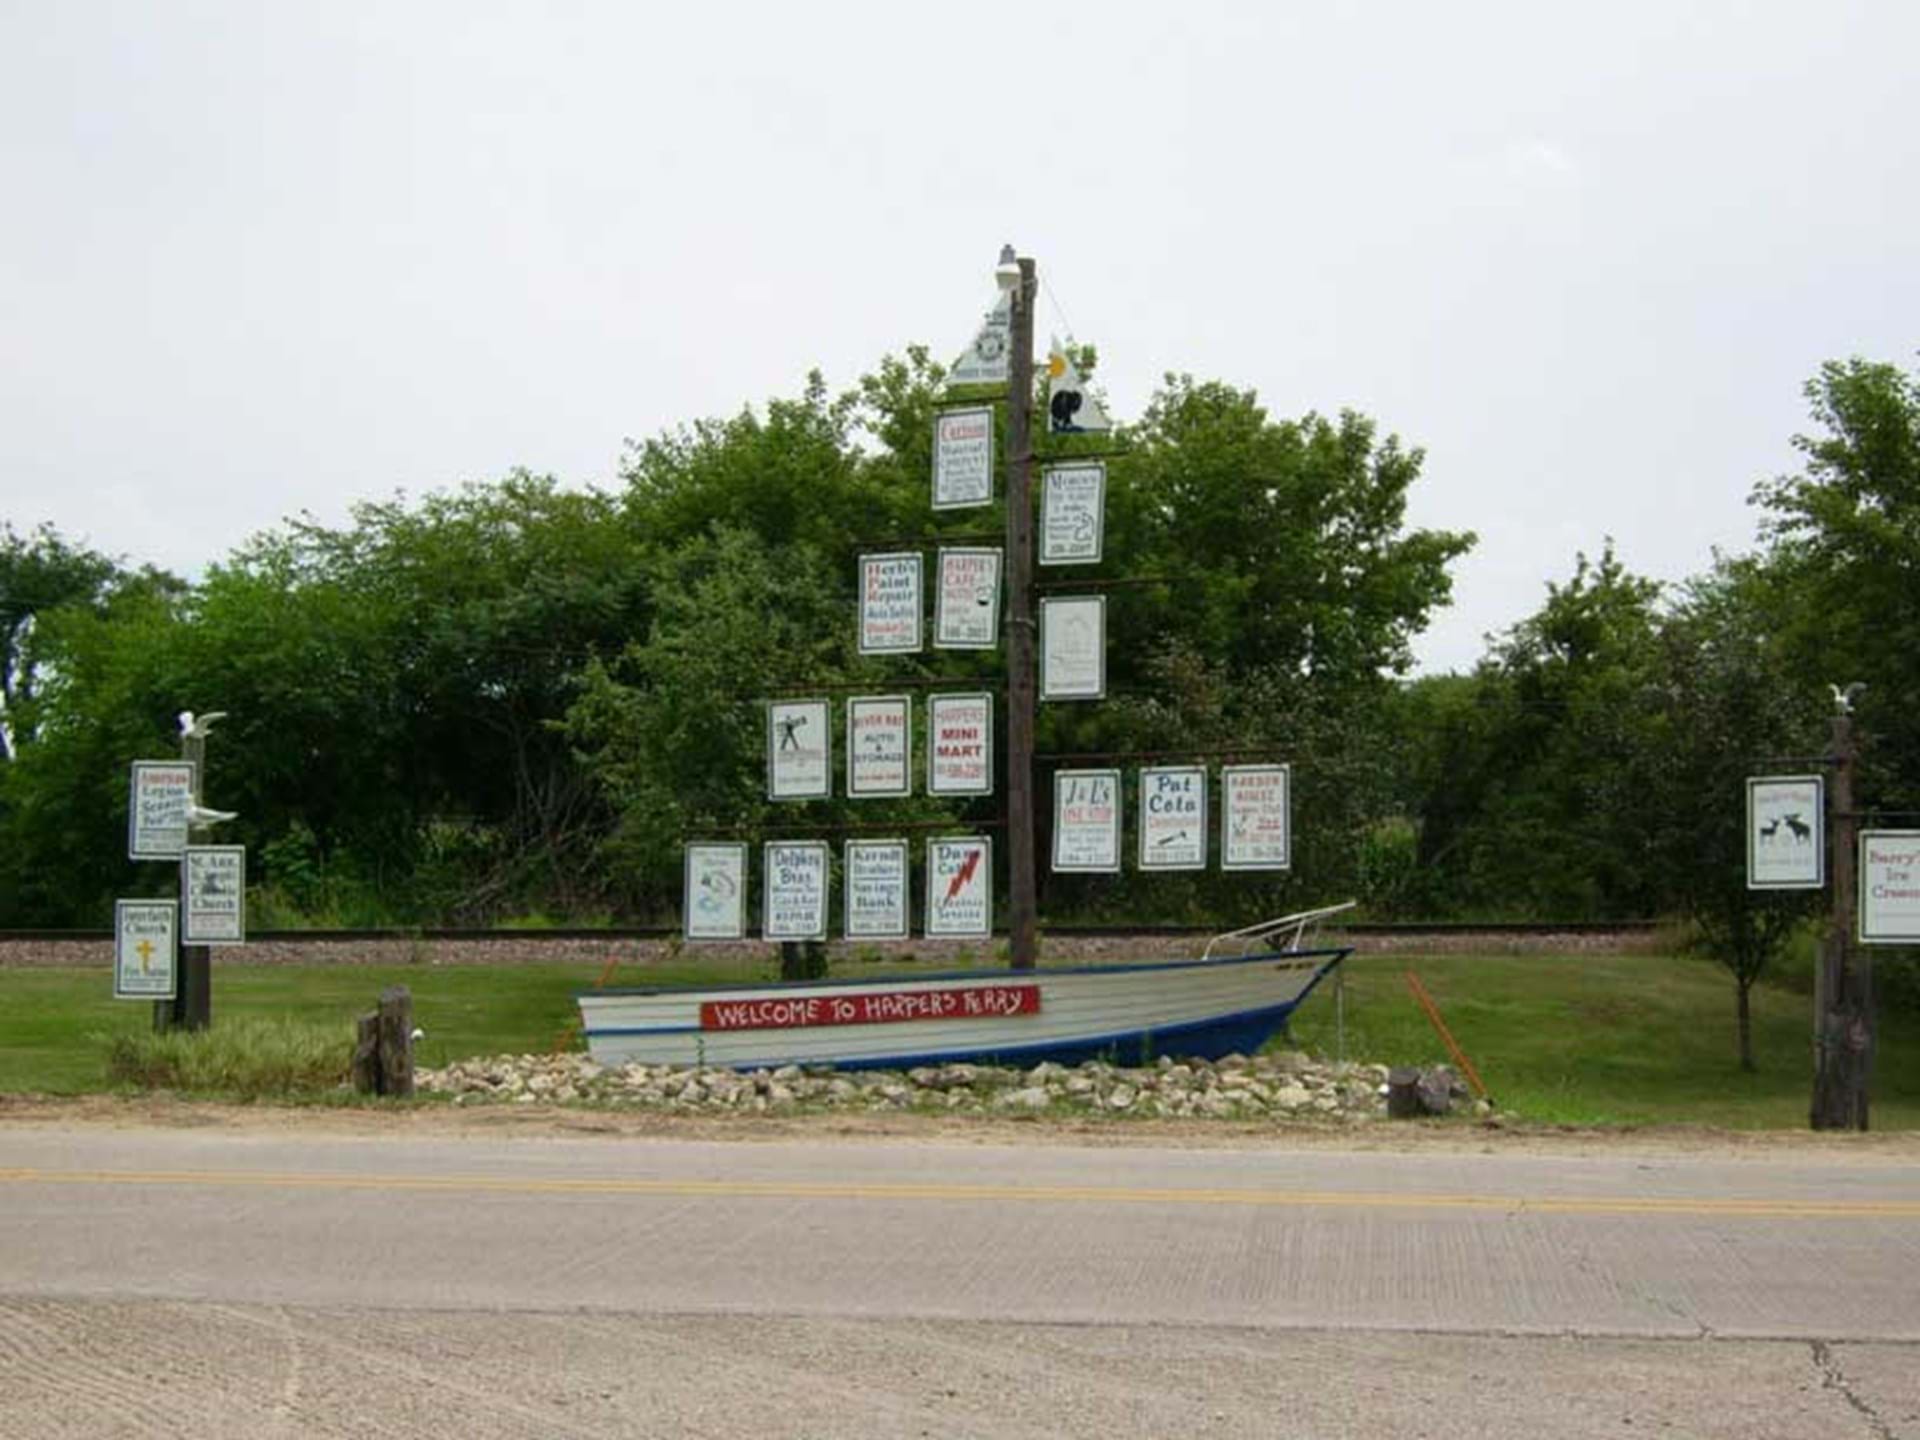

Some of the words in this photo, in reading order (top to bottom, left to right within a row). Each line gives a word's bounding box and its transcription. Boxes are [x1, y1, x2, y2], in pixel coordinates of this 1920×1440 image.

[868, 577, 910, 588] Paint
[941, 729, 979, 740] MINI
[937, 745, 982, 757] MART
[1157, 775, 1191, 792] Pat
[856, 895, 896, 908] Bank
[714, 999, 822, 1027] WELCOME
[830, 999, 856, 1018] TO
[864, 993, 957, 1018] HARPERS
